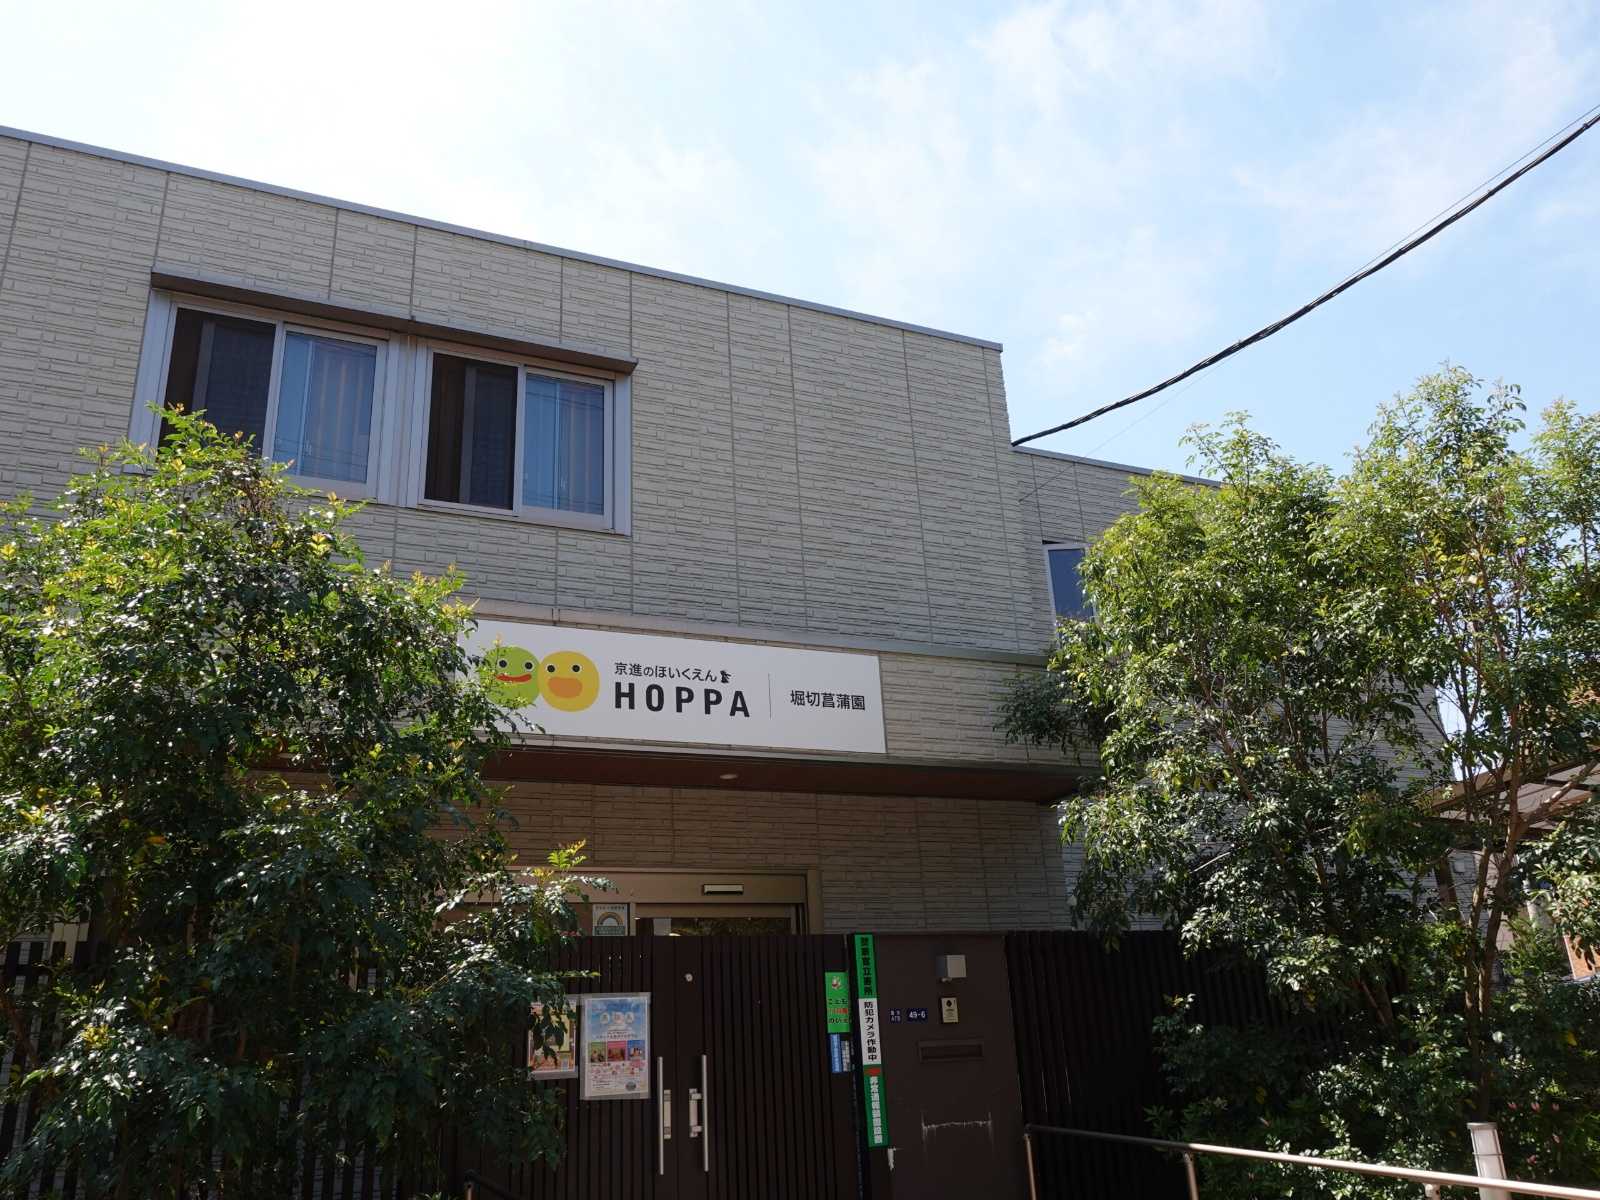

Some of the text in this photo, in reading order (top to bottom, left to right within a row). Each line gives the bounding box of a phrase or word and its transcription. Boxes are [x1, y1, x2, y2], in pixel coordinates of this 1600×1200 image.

[614, 662, 718, 682] 京進のほいくえん
[614, 681, 750, 718] HOPPA
[790, 690, 866, 711] 堀切菖蒲園
[863, 1001, 878, 1062] 防犯カメラ作動中
